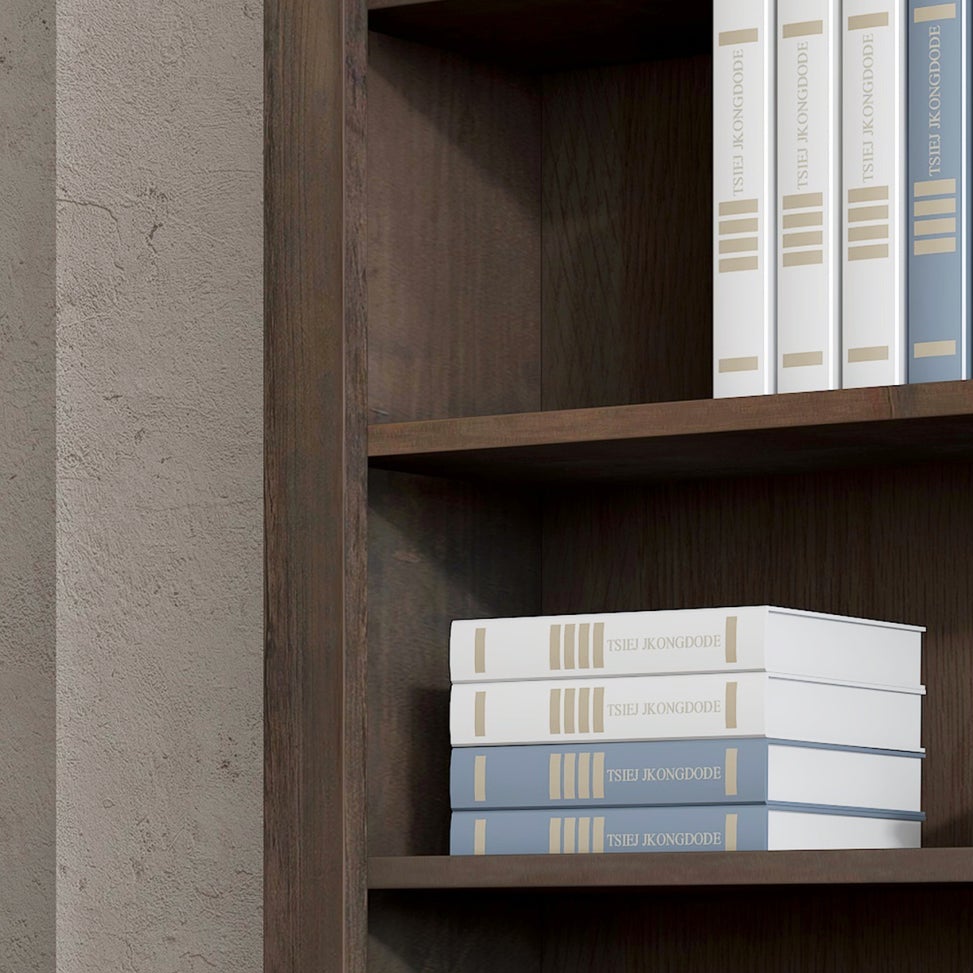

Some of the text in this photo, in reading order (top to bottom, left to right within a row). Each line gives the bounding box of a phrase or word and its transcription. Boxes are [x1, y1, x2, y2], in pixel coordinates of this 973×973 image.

[732, 49, 744, 196] TSIEJ JKONGDODE
[797, 41, 808, 190] TSIEJ JKONGDODE
[862, 33, 874, 183] TSIEJ JKONGDODE
[928, 25, 941, 177] TSIEJ JKONGDODE
[607, 635, 721, 652] TSIEJ JKONGDODE
[607, 700, 721, 716] TSIEJ JKONGDODE
[607, 766, 721, 782] TSIEJ JKONGDODE
[607, 832, 721, 847] TSIEJ JKONGDODE
